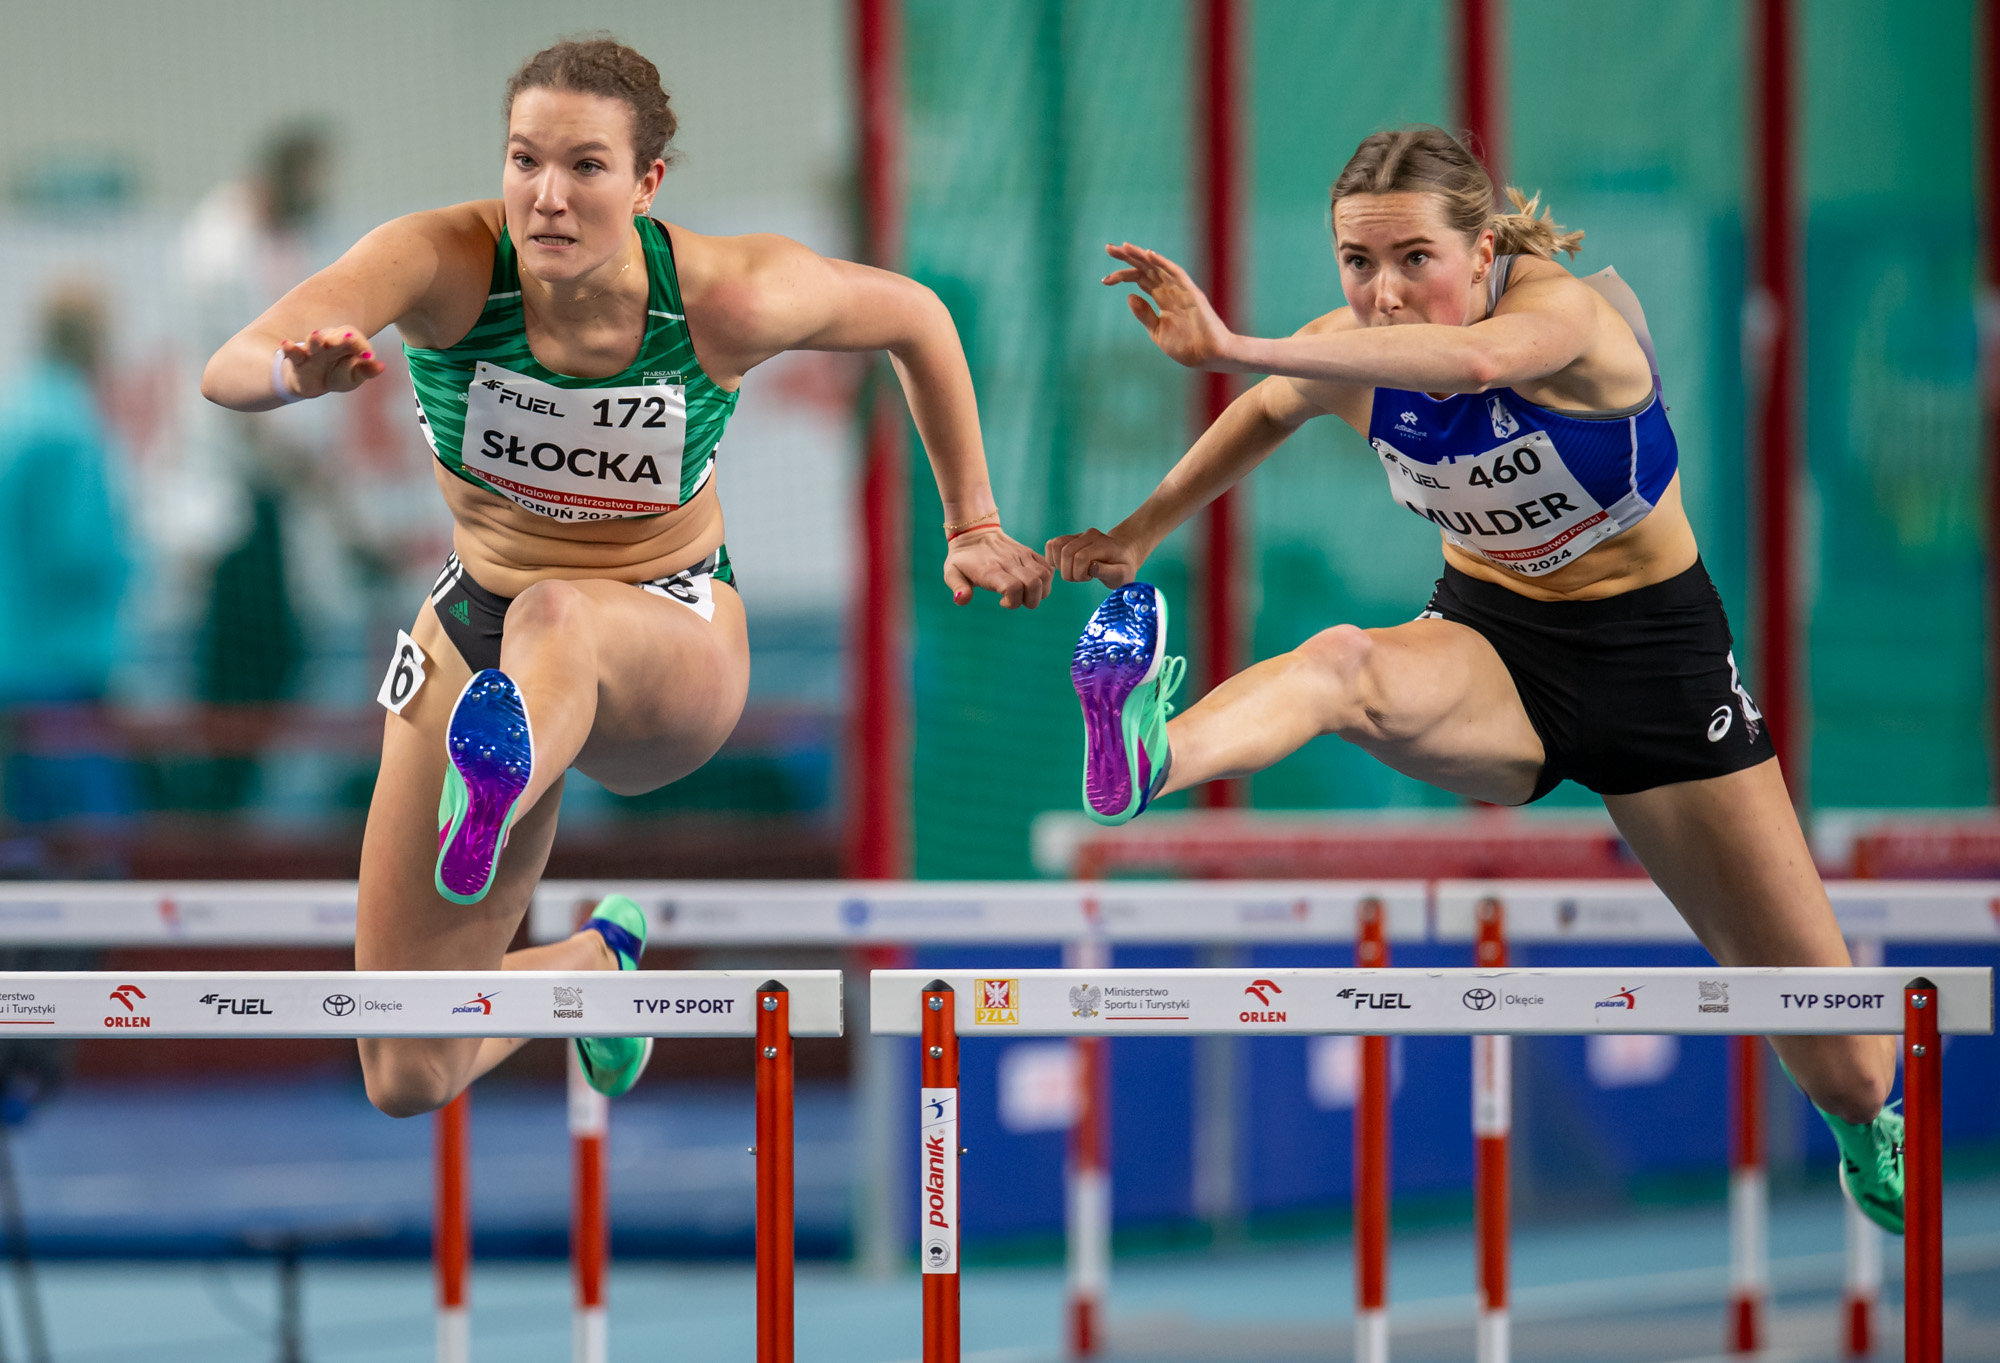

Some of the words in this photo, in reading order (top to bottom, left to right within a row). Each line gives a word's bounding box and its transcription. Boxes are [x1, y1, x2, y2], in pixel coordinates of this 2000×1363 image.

[499, 388, 565, 417] FUEL
[592, 396, 666, 428] 172
[480, 430, 662, 485] SŁOCKA
[1400, 462, 1450, 490] FUEL
[1468, 447, 1542, 489] 460
[490, 475, 515, 490] PZLA
[518, 485, 561, 501] Halowe
[563, 494, 635, 511] Mistrzostwa
[636, 503, 671, 513] Polski
[511, 494, 573, 520] TORUŃ
[1405, 491, 1580, 537] MULDER
[1506, 534, 1569, 559] Mistrzostwa
[1569, 514, 1602, 536] Polski
[1528, 548, 1572, 573] 2024
[448, 605, 471, 626] adidas
[390, 644, 416, 705] 6
[1104, 987, 1169, 997] Ministerstwo
[1504, 993, 1545, 1007] Okęcie
[12, 1003, 56, 1015] Turystyki
[217, 999, 273, 1015] FUEL
[364, 1000, 403, 1012] Okęcie
[452, 1005, 483, 1014] polanik
[633, 999, 671, 1014] TVP
[675, 999, 735, 1014] SPORT
[1104, 999, 1137, 1011] Sportu
[1146, 999, 1190, 1011] Turystyki
[1355, 993, 1412, 1010] FUEL
[1594, 1000, 1627, 1009] polanik
[1781, 994, 1819, 1009] TVP
[1823, 994, 1885, 1009] SPORT
[104, 1016, 150, 1028] ORLEN
[977, 1010, 1017, 1023] PZLA
[1239, 1011, 1287, 1023] ORLEN
[925, 1134, 949, 1229] polanik
